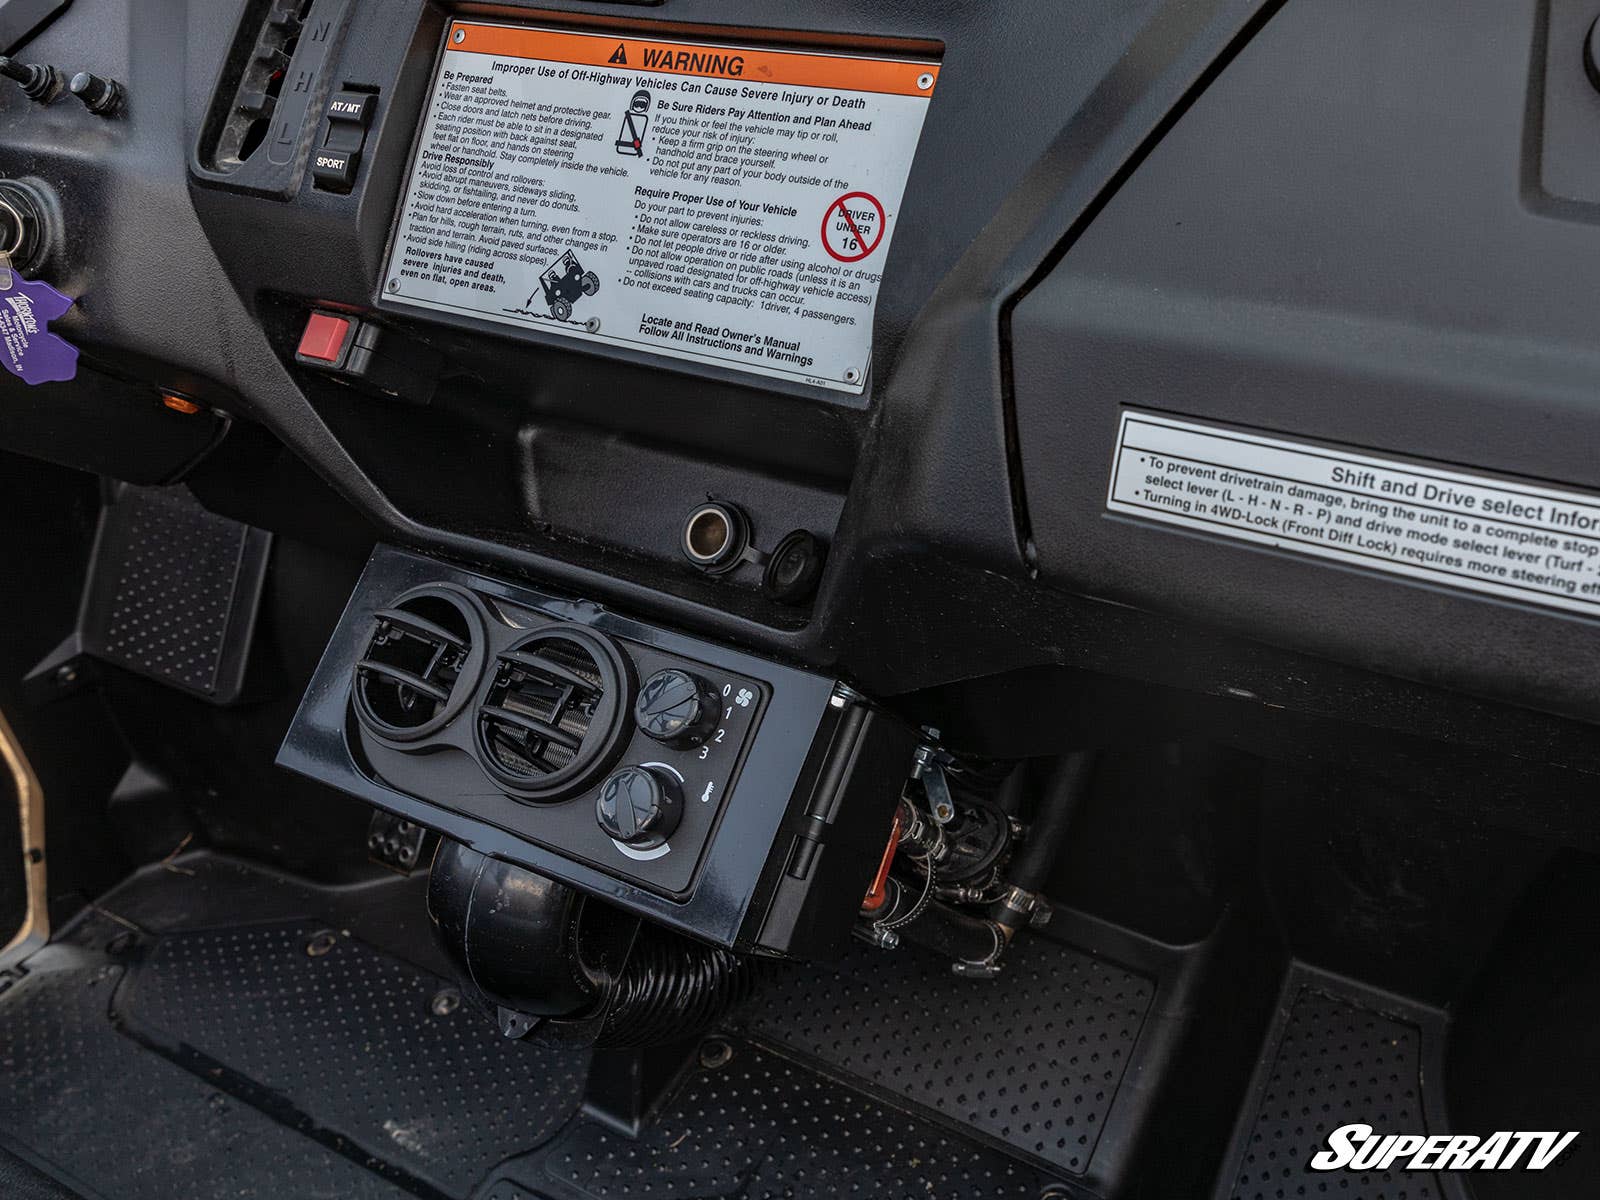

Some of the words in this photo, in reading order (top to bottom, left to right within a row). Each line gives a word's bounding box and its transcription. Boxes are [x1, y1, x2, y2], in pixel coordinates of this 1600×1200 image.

[313, 22, 331, 42] N
[642, 48, 745, 76] WARNING
[294, 72, 313, 93] H
[443, 70, 454, 80] Be
[454, 71, 493, 84] Prepared
[491, 60, 535, 76] Improper
[537, 65, 556, 77] Use
[558, 68, 570, 79] of
[571, 69, 632, 88] Off-Highway
[635, 76, 677, 90] Vehicles
[680, 80, 701, 93] Can
[704, 83, 738, 97] Cause
[740, 86, 778, 101] Severe
[781, 90, 814, 106] Injury
[816, 96, 829, 105] or
[831, 95, 865, 109] Death
[330, 101, 361, 114] AT/MT
[440, 100, 461, 111] Close
[462, 104, 483, 114] doors
[484, 107, 500, 116] and
[500, 108, 519, 119] latch
[519, 112, 537, 121] nets
[537, 113, 563, 124] before
[562, 116, 592, 130] driving.
[443, 90, 463, 100] Wear
[462, 94, 473, 102] an
[473, 95, 509, 107] approved
[509, 99, 536, 110] helmet
[536, 103, 553, 112] and
[552, 105, 591, 117] protective
[591, 110, 611, 120] gear.
[656, 99, 670, 109] Be
[671, 101, 693, 112] Sure
[694, 103, 726, 116] Riders
[727, 107, 745, 120] Pay
[746, 109, 790, 123] Attention
[792, 115, 812, 125] and
[813, 115, 836, 127] Plan
[837, 118, 872, 131] Ahead
[278, 124, 292, 145] L
[660, 116, 677, 125] you
[678, 116, 699, 127] think
[700, 120, 710, 128] or
[711, 119, 728, 130] feel
[728, 121, 742, 132] the
[744, 124, 774, 135] vehicle
[775, 128, 795, 139] may
[796, 130, 808, 140] tip
[810, 132, 820, 140] or
[821, 132, 838, 143] roll,
[316, 158, 345, 171] SPORT
[421, 150, 443, 161] Drive
[444, 153, 494, 171] Responsibly
[634, 185, 670, 199] Require
[671, 190, 704, 204] Proper
[705, 195, 724, 206] Use
[725, 199, 737, 208] of
[739, 199, 760, 211] Your
[762, 202, 797, 217] Vehicle
[838, 209, 876, 222] DRIVER
[636, 223, 659, 236] Make
[660, 229, 679, 239] sure
[680, 232, 721, 245] operators
[722, 238, 737, 247] are
[740, 239, 751, 249] 16
[751, 242, 761, 251] or
[762, 243, 786, 255] older.
[639, 213, 652, 223] Do
[653, 217, 667, 226] not
[668, 218, 691, 229] allow
[692, 222, 727, 235] careless
[728, 228, 739, 236] or
[739, 230, 776, 242] reckless
[777, 234, 810, 249] driving.
[836, 222, 871, 235] UNDER
[842, 237, 858, 251] 16
[405, 246, 442, 260] Rollovers
[443, 252, 463, 264] have
[464, 258, 494, 269] caused
[400, 268, 419, 278] even
[420, 272, 431, 280] on
[432, 272, 447, 284] flat,
[449, 278, 469, 287] open
[471, 282, 495, 293] areas.
[402, 258, 428, 269] severe
[432, 261, 462, 275] injuries
[463, 269, 480, 278] and
[480, 271, 505, 284] death,
[641, 312, 672, 327] Locate
[674, 321, 693, 331] and
[694, 322, 720, 336] Read
[721, 327, 761, 344] Owner's
[763, 335, 800, 351] Manual
[638, 323, 670, 338] Follow
[670, 330, 685, 341] All
[685, 332, 742, 352] Instructions
[744, 345, 764, 356] and
[766, 347, 813, 367] Warnings
[1150, 456, 1164, 469] To
[1166, 462, 1216, 480] prevent
[1219, 471, 1283, 494] drivetrain
[1287, 485, 1346, 508] damage,
[1350, 497, 1388, 518] bring
[1392, 506, 1416, 520] the
[1419, 513, 1449, 527] unit
[1453, 518, 1468, 531] to
[1472, 523, 1481, 533] a
[1485, 526, 1558, 548] complete
[1563, 541, 1599, 557] stop
[1331, 466, 1375, 486] Shift
[1380, 479, 1418, 495] and
[1423, 484, 1475, 506] Drive
[1481, 498, 1543, 520] select
[1549, 507, 1600, 532] Infor
[1145, 475, 1183, 491] select
[1186, 481, 1219, 497] lever
[1221, 488, 1234, 502] (L
[1247, 494, 1258, 506] H
[1270, 498, 1281, 511] N
[1293, 503, 1304, 516] R
[1316, 508, 1331, 524] P)
[1335, 514, 1362, 527] and
[1365, 519, 1402, 535] drive
[1406, 529, 1448, 545] mode
[1452, 538, 1498, 555] select
[1502, 546, 1541, 563] lever
[1545, 554, 1583, 571] (Turf
[1144, 488, 1191, 512] Turning
[1194, 500, 1207, 513] in
[1210, 504, 1278, 528] 4WD-Lock
[1282, 519, 1324, 538] (Front
[1328, 528, 1353, 544] Diff
[1356, 535, 1397, 556] Lock)
[1400, 546, 1462, 567] requires
[1467, 560, 1507, 576] more
[1511, 569, 1577, 593] steering
[723, 684, 732, 697] 0
[726, 706, 733, 720] 1
[714, 729, 725, 743] 2
[699, 746, 709, 760] 3
